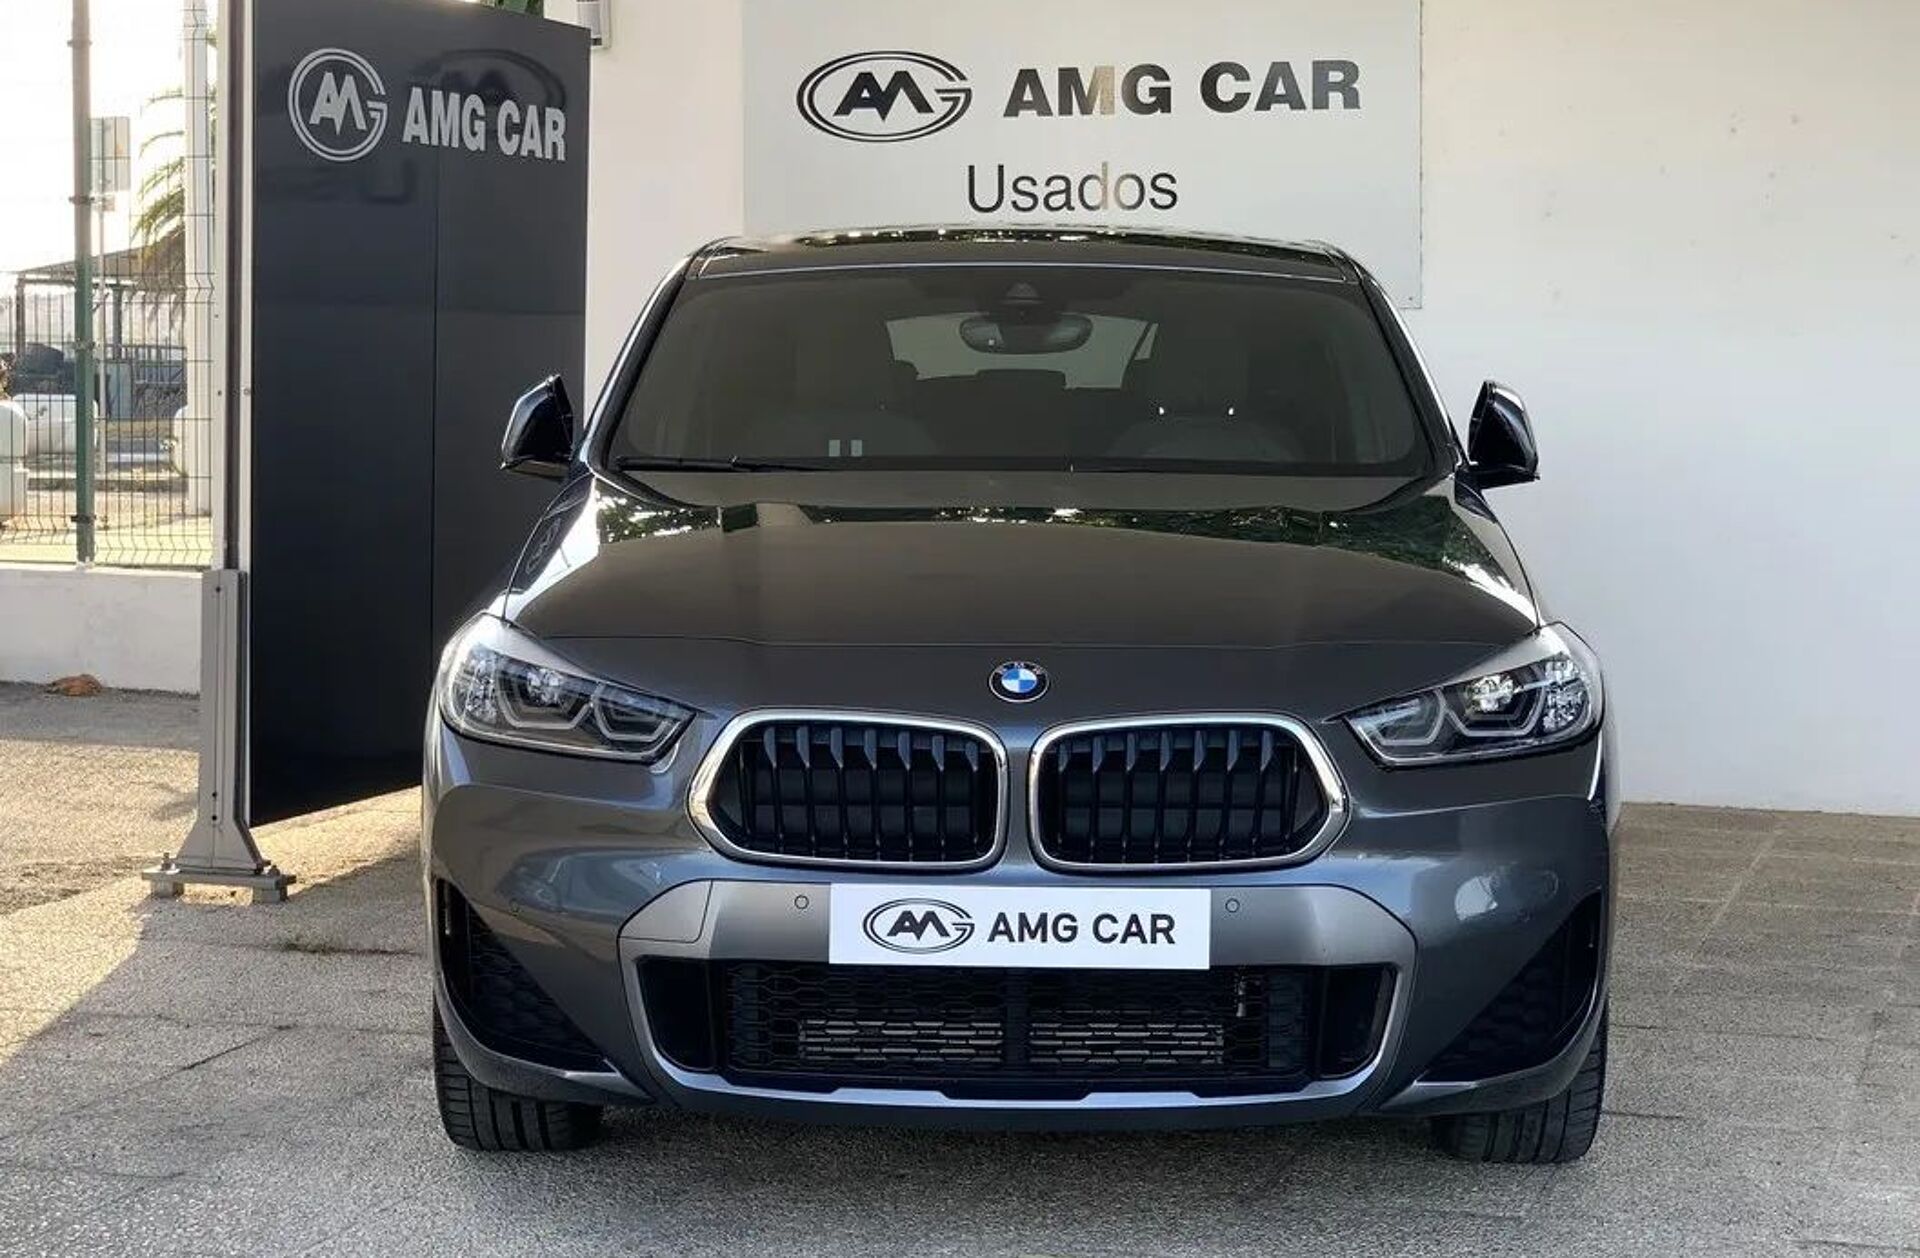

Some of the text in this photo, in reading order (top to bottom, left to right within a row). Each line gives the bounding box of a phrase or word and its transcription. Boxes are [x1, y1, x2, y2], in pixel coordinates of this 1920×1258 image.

[1003, 64, 1173, 117] AMG
[1199, 59, 1361, 111] CAR
[402, 87, 486, 151] AMG
[497, 100, 566, 161] CAR
[967, 162, 1178, 213] Usados
[987, 912, 1078, 943] AMG
[1092, 913, 1176, 944] CAR
